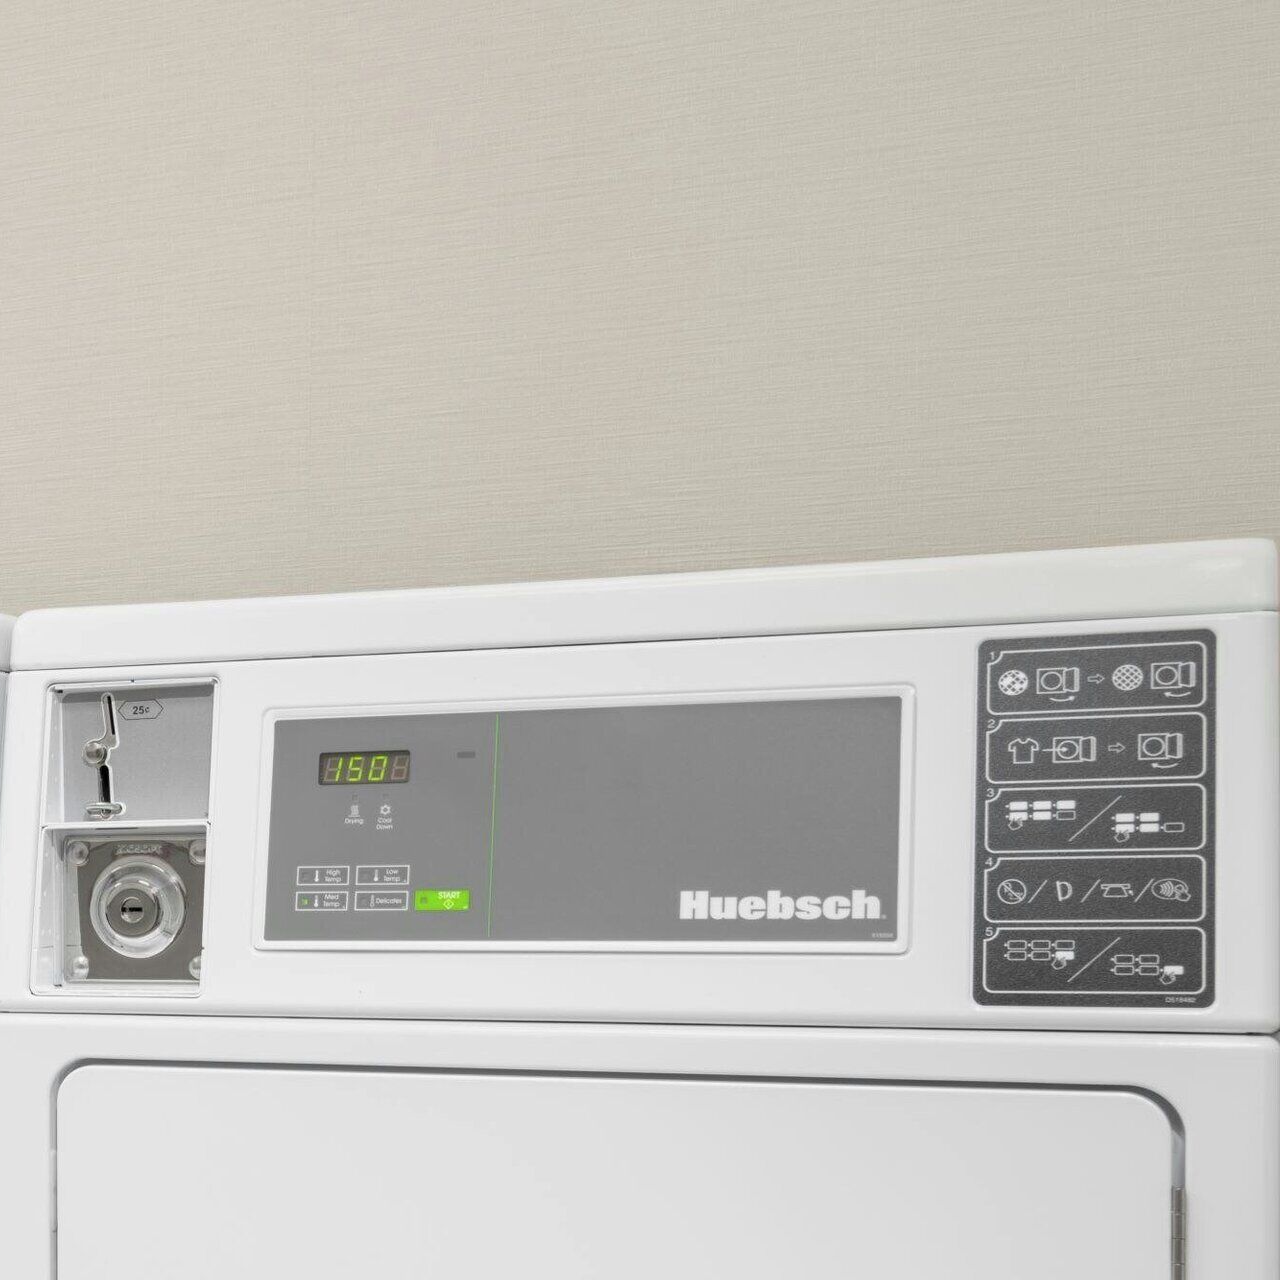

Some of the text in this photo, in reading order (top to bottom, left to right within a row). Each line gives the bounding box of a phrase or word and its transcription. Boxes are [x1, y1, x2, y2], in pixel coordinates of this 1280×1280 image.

[990, 652, 995, 660] 1
[132, 706, 150, 715] 25¢
[987, 719, 995, 728] 2
[335, 756, 388, 782] 150
[987, 788, 994, 797] 3
[984, 857, 993, 866] 4
[437, 891, 461, 899] START
[679, 889, 881, 920] Huebsch
[985, 927, 993, 936] 5
